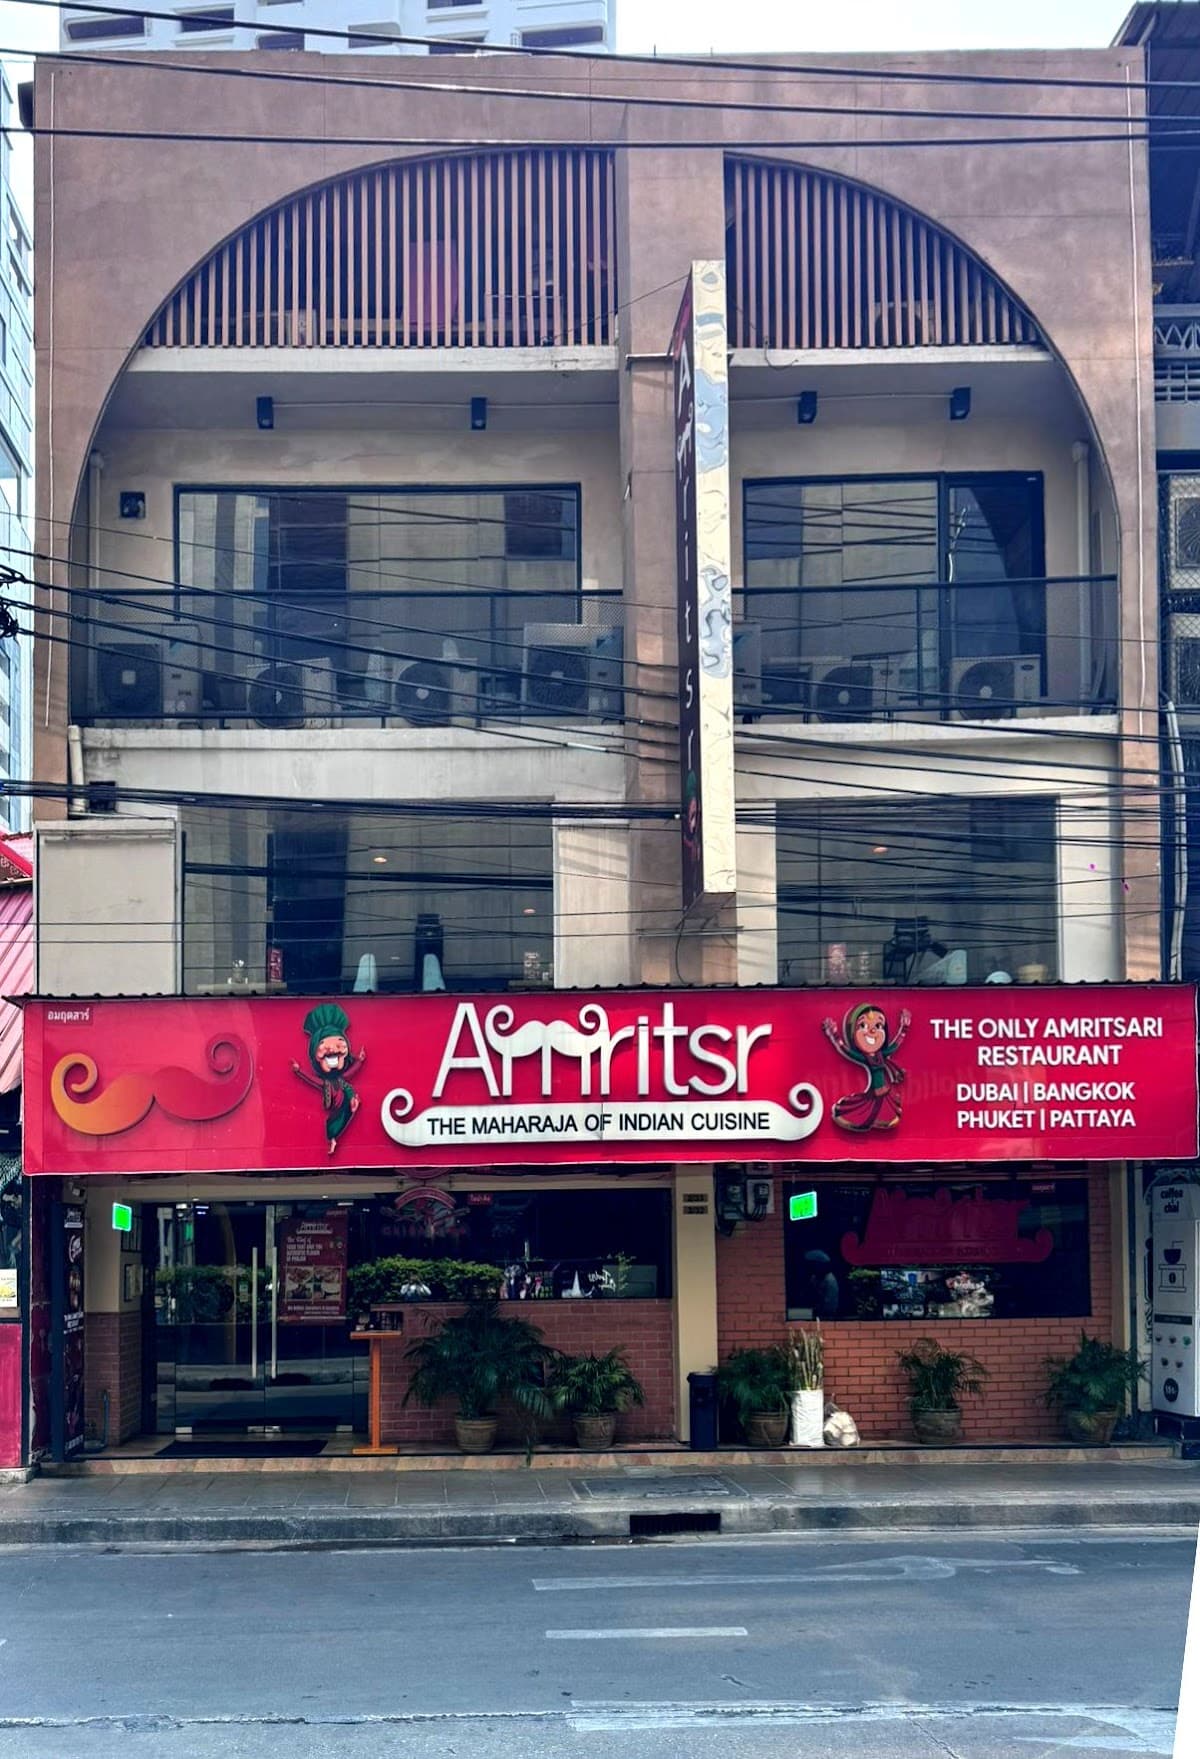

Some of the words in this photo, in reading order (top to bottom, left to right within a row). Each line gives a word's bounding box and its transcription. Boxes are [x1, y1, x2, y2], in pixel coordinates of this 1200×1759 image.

[930, 1018, 973, 1039] THE
[978, 1018, 1039, 1039] ONLY
[1043, 1017, 1163, 1038] AMRITSARI
[431, 1002, 773, 1099] Amritsr
[977, 1045, 1123, 1066] RESTAURANT
[957, 1083, 1019, 1102] DUBAI
[1033, 1082, 1136, 1101] BANGKOK
[427, 1116, 466, 1135] THE
[471, 1114, 579, 1134] MAHARAJA
[584, 1113, 612, 1132] OF
[619, 1112, 684, 1131] INDIAN
[690, 1111, 770, 1130] CUISINE
[957, 1110, 1036, 1129] PHUKET
[1050, 1109, 1136, 1128] PATTAYA
